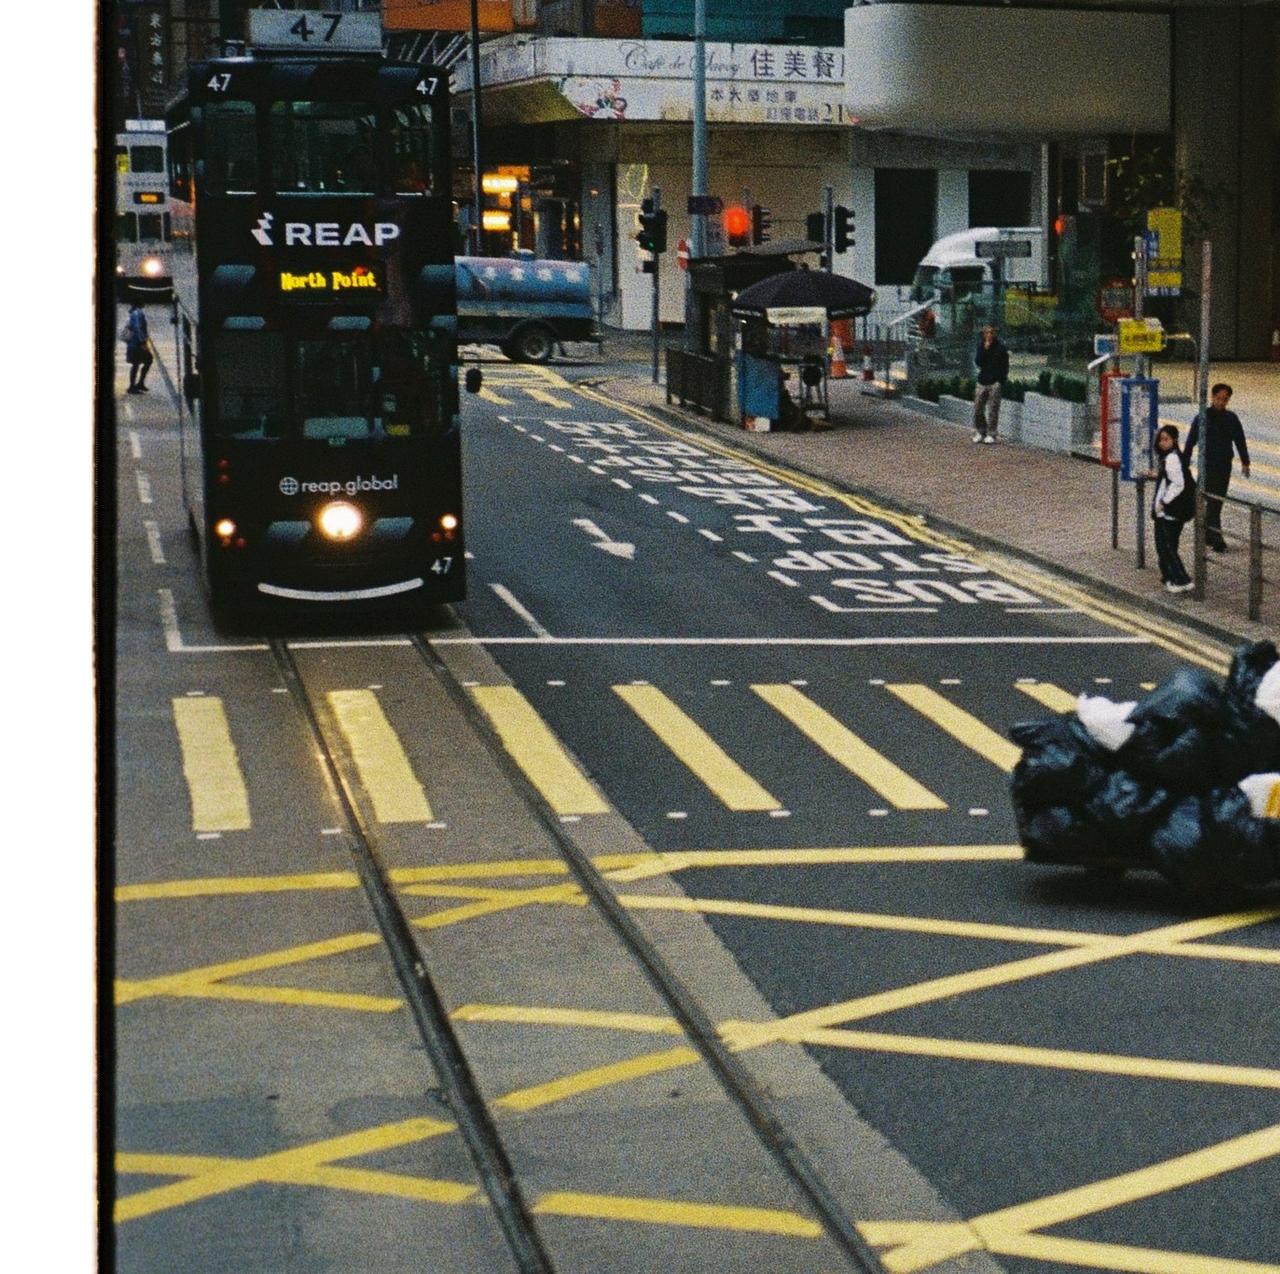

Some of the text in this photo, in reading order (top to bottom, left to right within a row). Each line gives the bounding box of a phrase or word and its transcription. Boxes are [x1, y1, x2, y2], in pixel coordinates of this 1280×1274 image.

[290, 13, 343, 42] 47
[206, 74, 232, 92] 47
[415, 77, 439, 95] 47
[285, 222, 400, 246] REAP
[280, 268, 377, 291] North Point
[593, 455, 758, 470] STOP
[302, 475, 399, 495] reap.global
[628, 469, 780, 486] BUS
[732, 514, 914, 545] 巴士
[430, 557, 453, 576] 47
[769, 549, 991, 574] STOP
[830, 578, 1043, 605] BUS
